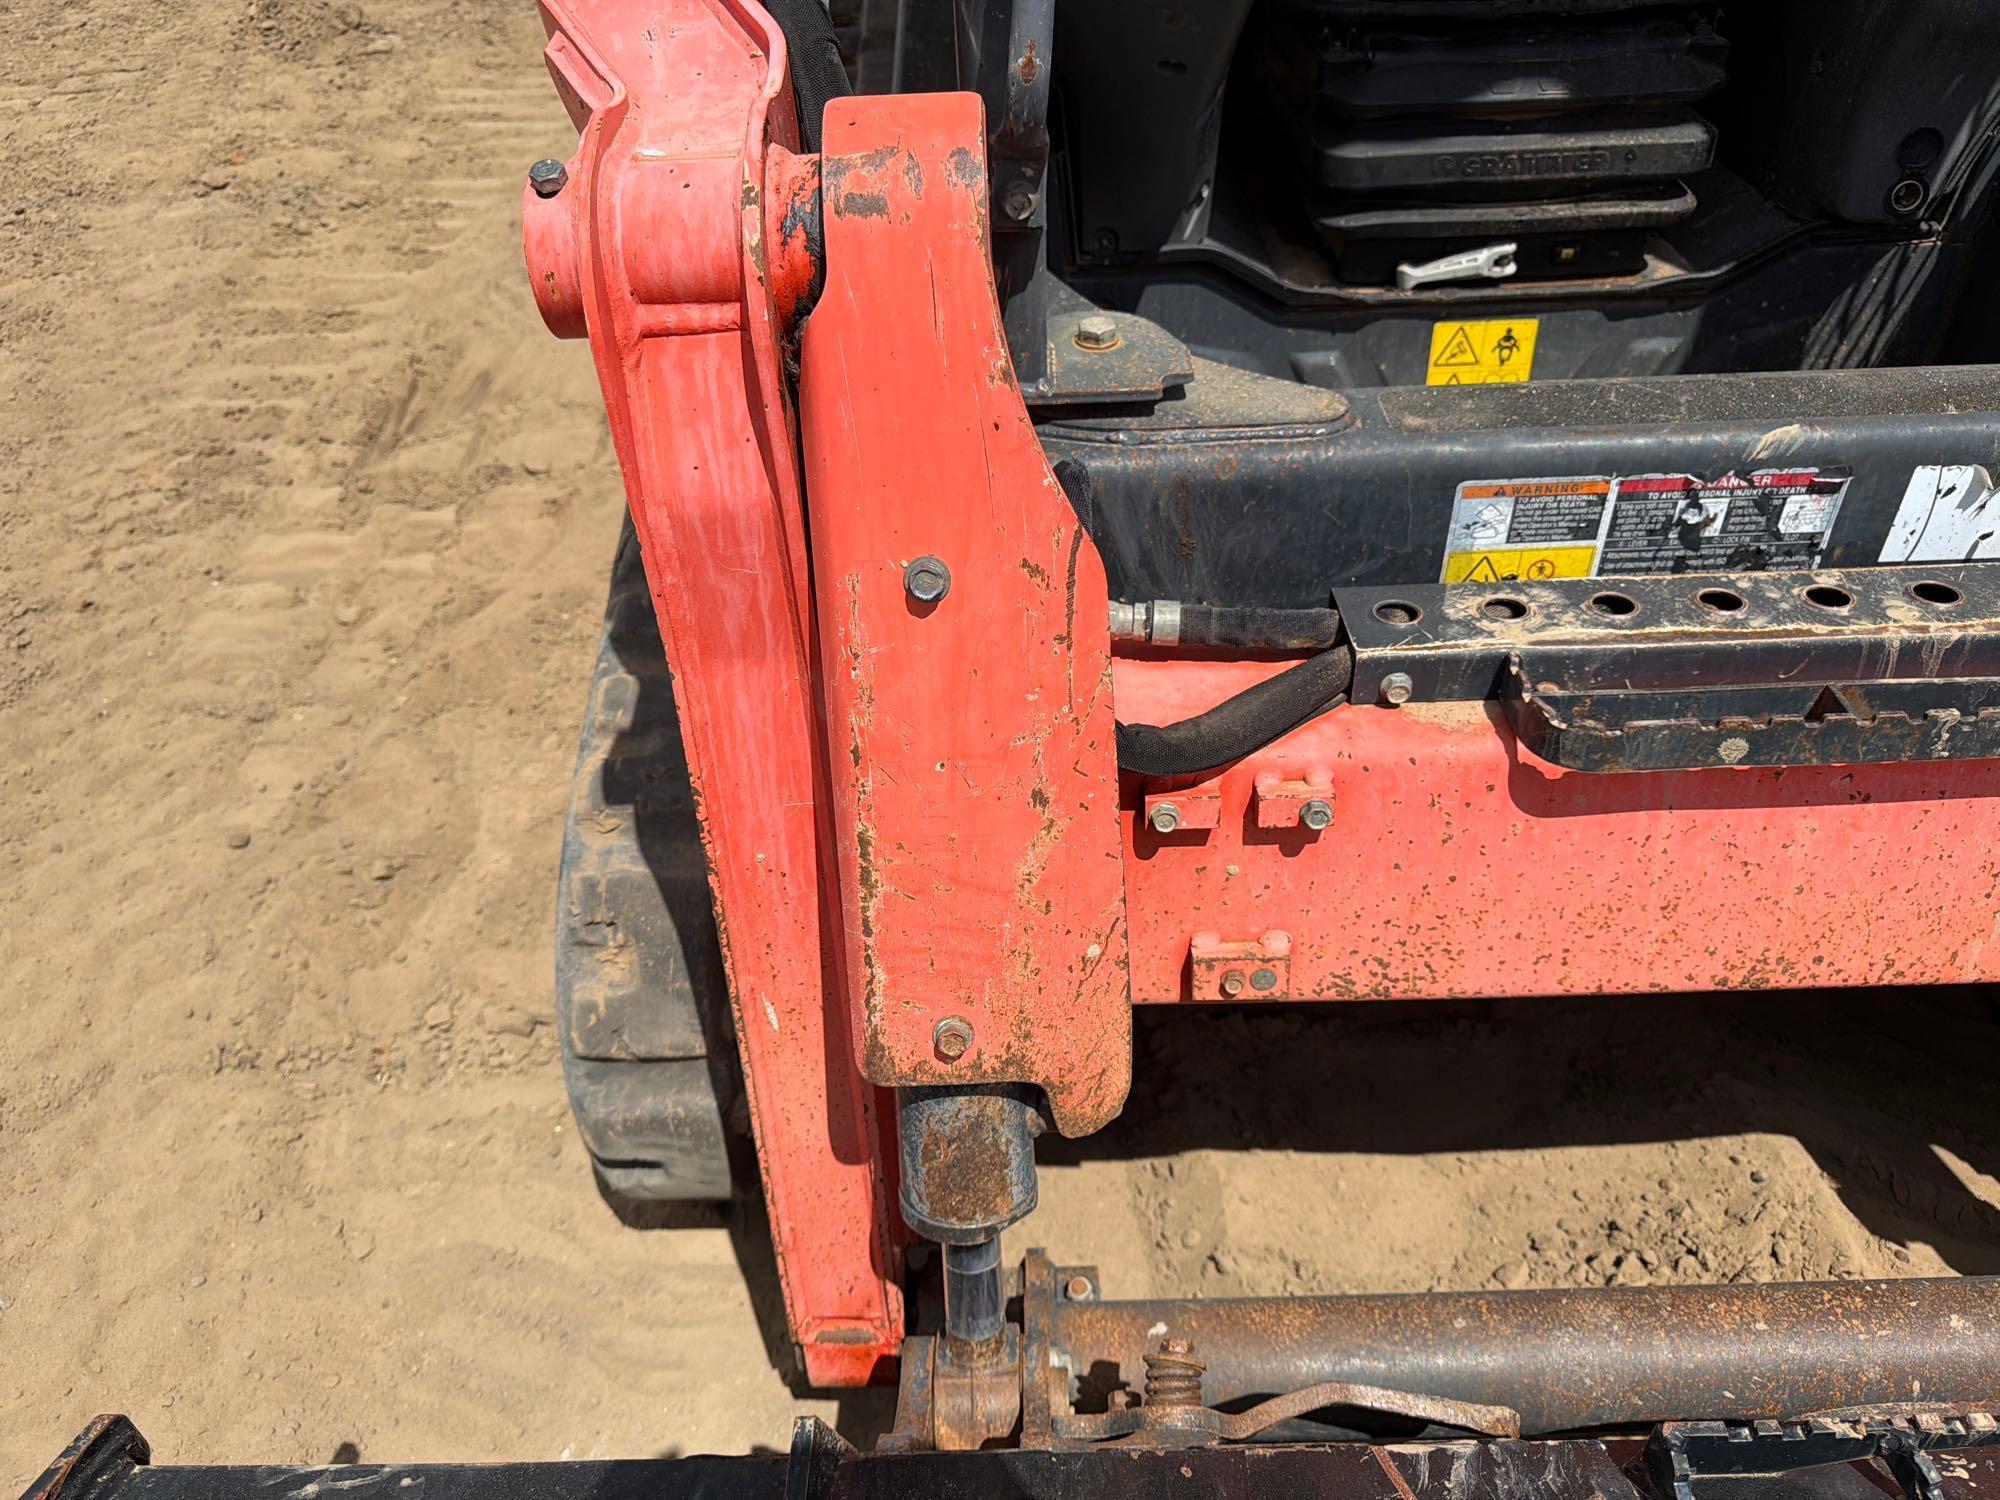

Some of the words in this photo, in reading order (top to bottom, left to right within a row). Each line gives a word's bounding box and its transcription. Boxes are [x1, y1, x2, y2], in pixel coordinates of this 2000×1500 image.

[1512, 484, 1580, 495] WARNING
[1648, 492, 1659, 500] TO
[1660, 491, 1687, 499] AVOID
[1690, 489, 1732, 498] RSONAL
[1518, 496, 1529, 504] TO
[1556, 494, 1599, 502] PERSONAL
